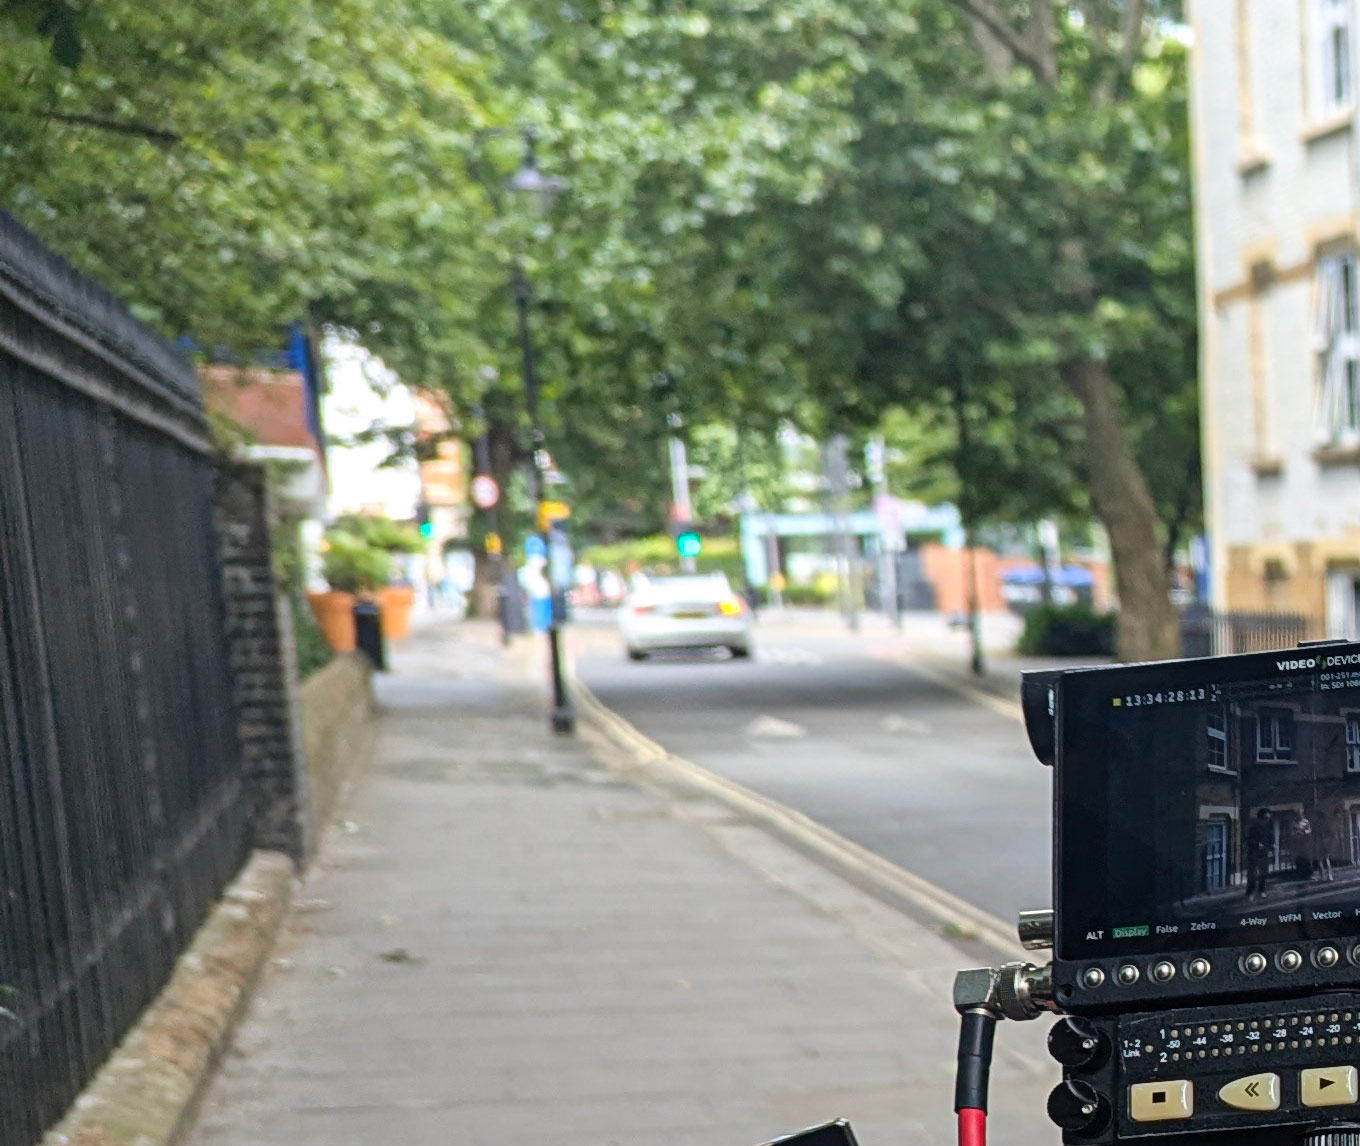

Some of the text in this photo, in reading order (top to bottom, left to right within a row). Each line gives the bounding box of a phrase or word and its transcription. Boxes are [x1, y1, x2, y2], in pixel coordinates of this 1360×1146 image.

[1276, 659, 1316, 671] VIDEO
[1126, 688, 1205, 707] 13:34:28:13
[1279, 913, 1302, 923] WFM
[1312, 910, 1342, 920] Vector
[1190, 921, 1216, 931] Zebra
[1240, 917, 1268, 928] 4-Way
[1114, 928, 1147, 938] Display
[1156, 924, 1179, 934] False
[1086, 930, 1104, 941] ALT
[1160, 1028, 1166, 1040] 1
[1166, 1040, 1180, 1048] -50
[1192, 1037, 1207, 1045] -44
[1220, 1034, 1234, 1043] -38
[1246, 1032, 1260, 1040] -32
[1272, 1029, 1286, 1038] -28
[1299, 1026, 1314, 1035] -24
[1326, 1024, 1340, 1033] -20
[1123, 1050, 1141, 1058] Link
[1160, 1052, 1168, 1062] 2
